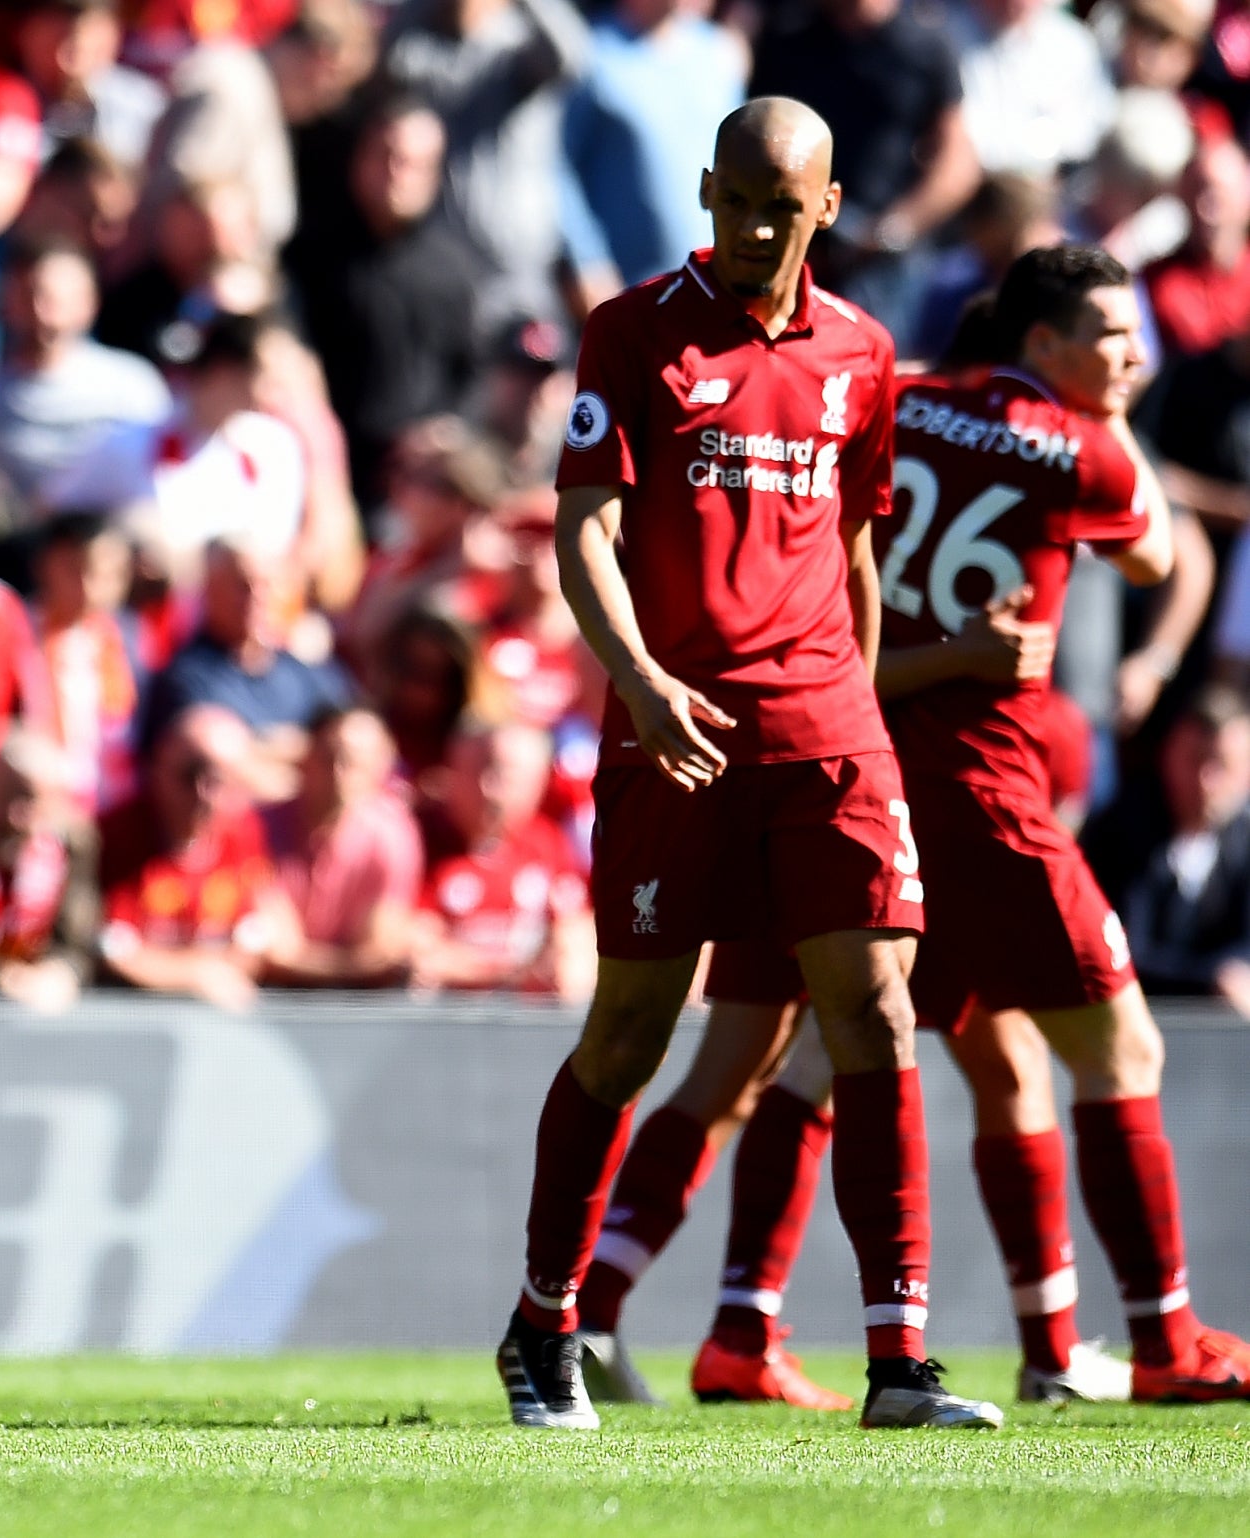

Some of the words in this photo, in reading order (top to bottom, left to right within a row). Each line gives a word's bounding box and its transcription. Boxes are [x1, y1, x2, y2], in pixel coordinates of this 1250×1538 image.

[700, 428, 814, 465] Standard
[687, 460, 810, 498] Chartered
[880, 456, 1026, 638] 26
[632, 923, 661, 934] LFC
